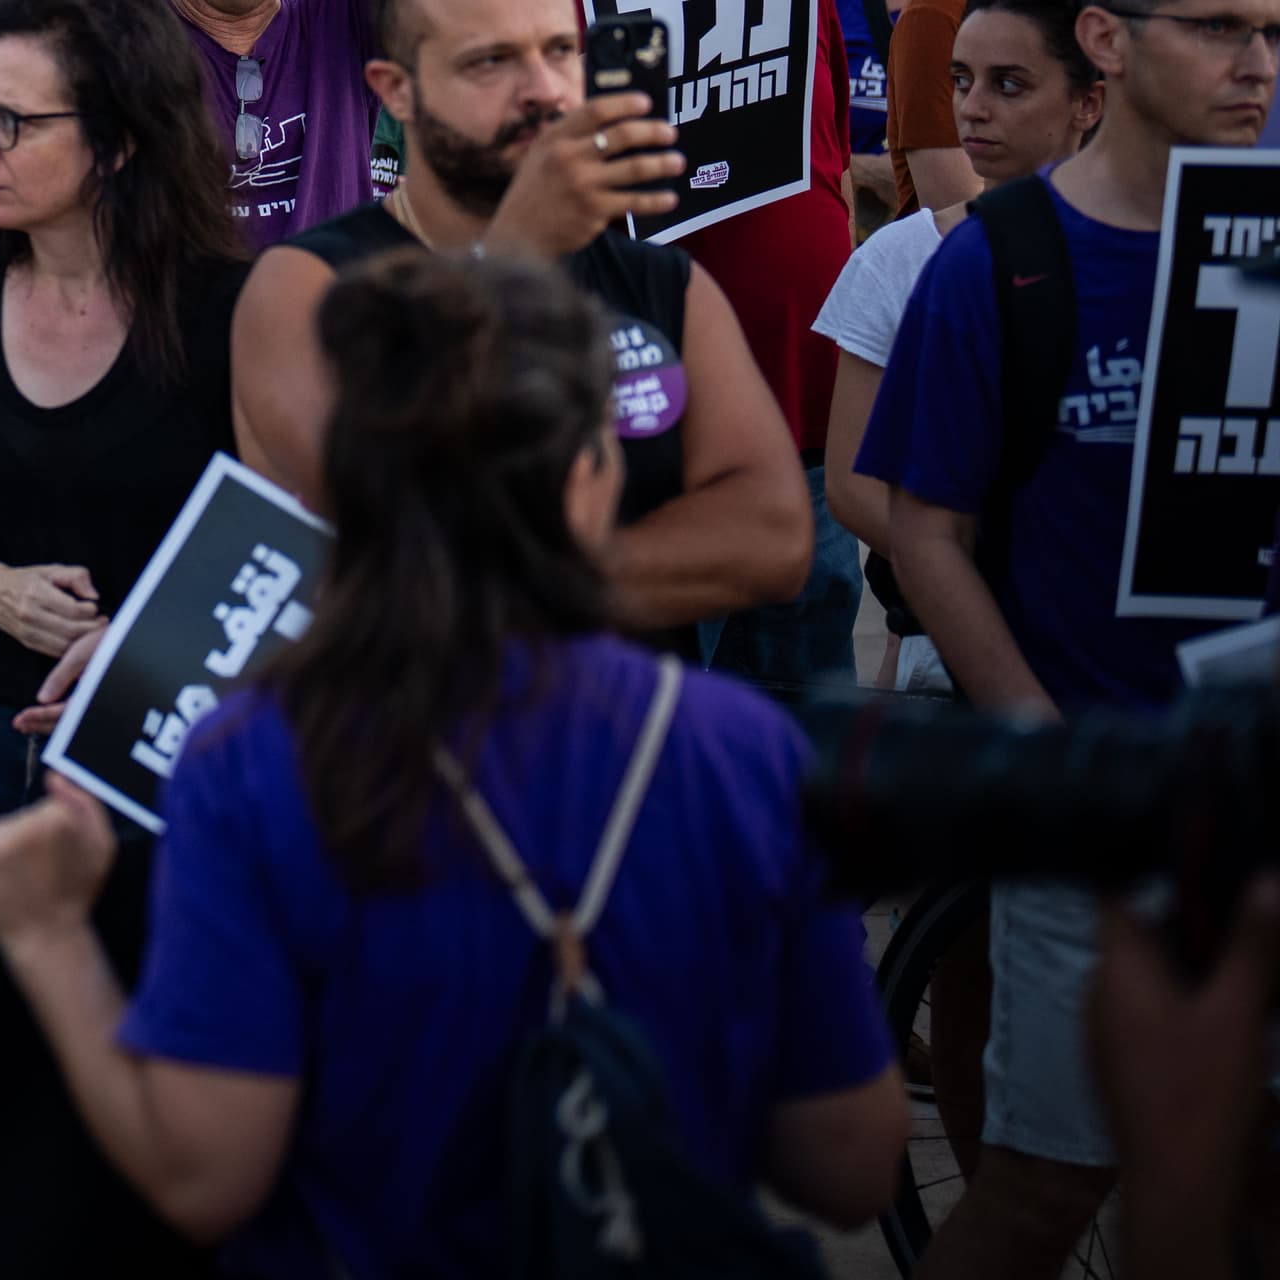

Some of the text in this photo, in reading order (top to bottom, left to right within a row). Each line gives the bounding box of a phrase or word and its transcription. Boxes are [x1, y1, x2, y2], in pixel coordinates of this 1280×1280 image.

[667, 55, 789, 127] ההרע
[1203, 214, 1280, 257] יחד
[1058, 390, 1139, 425] ביח
[203, 542, 302, 678] نقف
